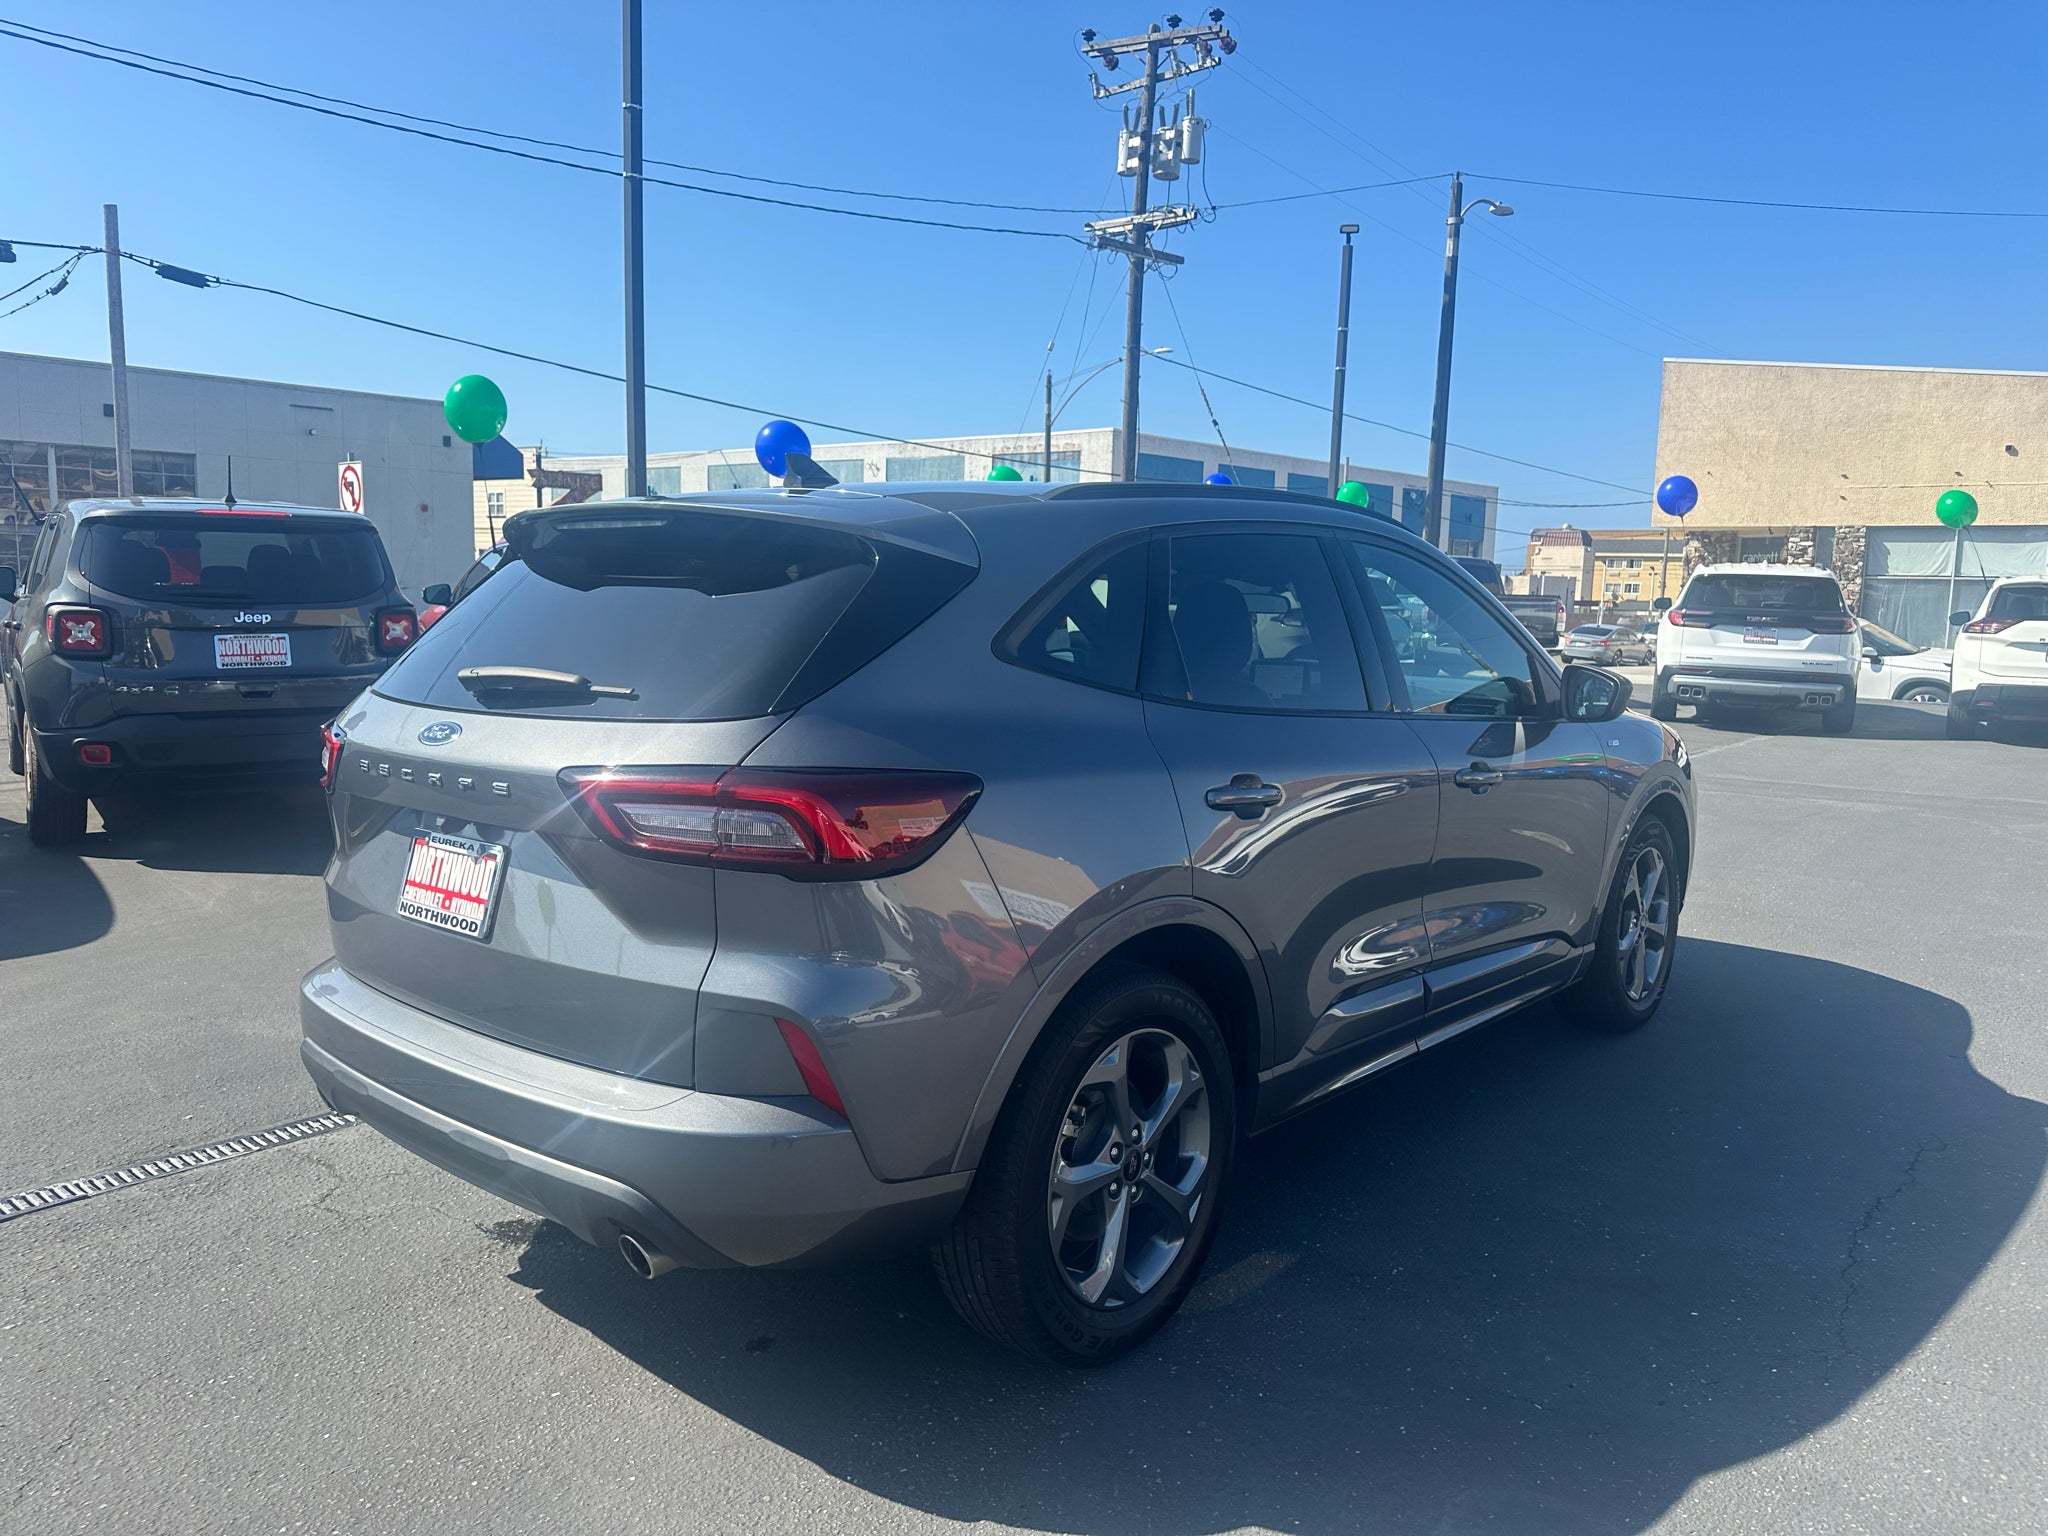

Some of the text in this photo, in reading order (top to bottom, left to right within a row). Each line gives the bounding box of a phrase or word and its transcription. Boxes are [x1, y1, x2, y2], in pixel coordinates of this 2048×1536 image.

[234, 611, 271, 624] Jeep
[219, 639, 287, 655] NORTHWOOD
[261, 654, 286, 662] HYUNDA
[431, 835, 475, 852] EUREKA
[408, 843, 496, 900] NORTHWOOD
[403, 884, 486, 920] CHEVROLET HYUNDA
[399, 901, 479, 933] NORTHWOOD
